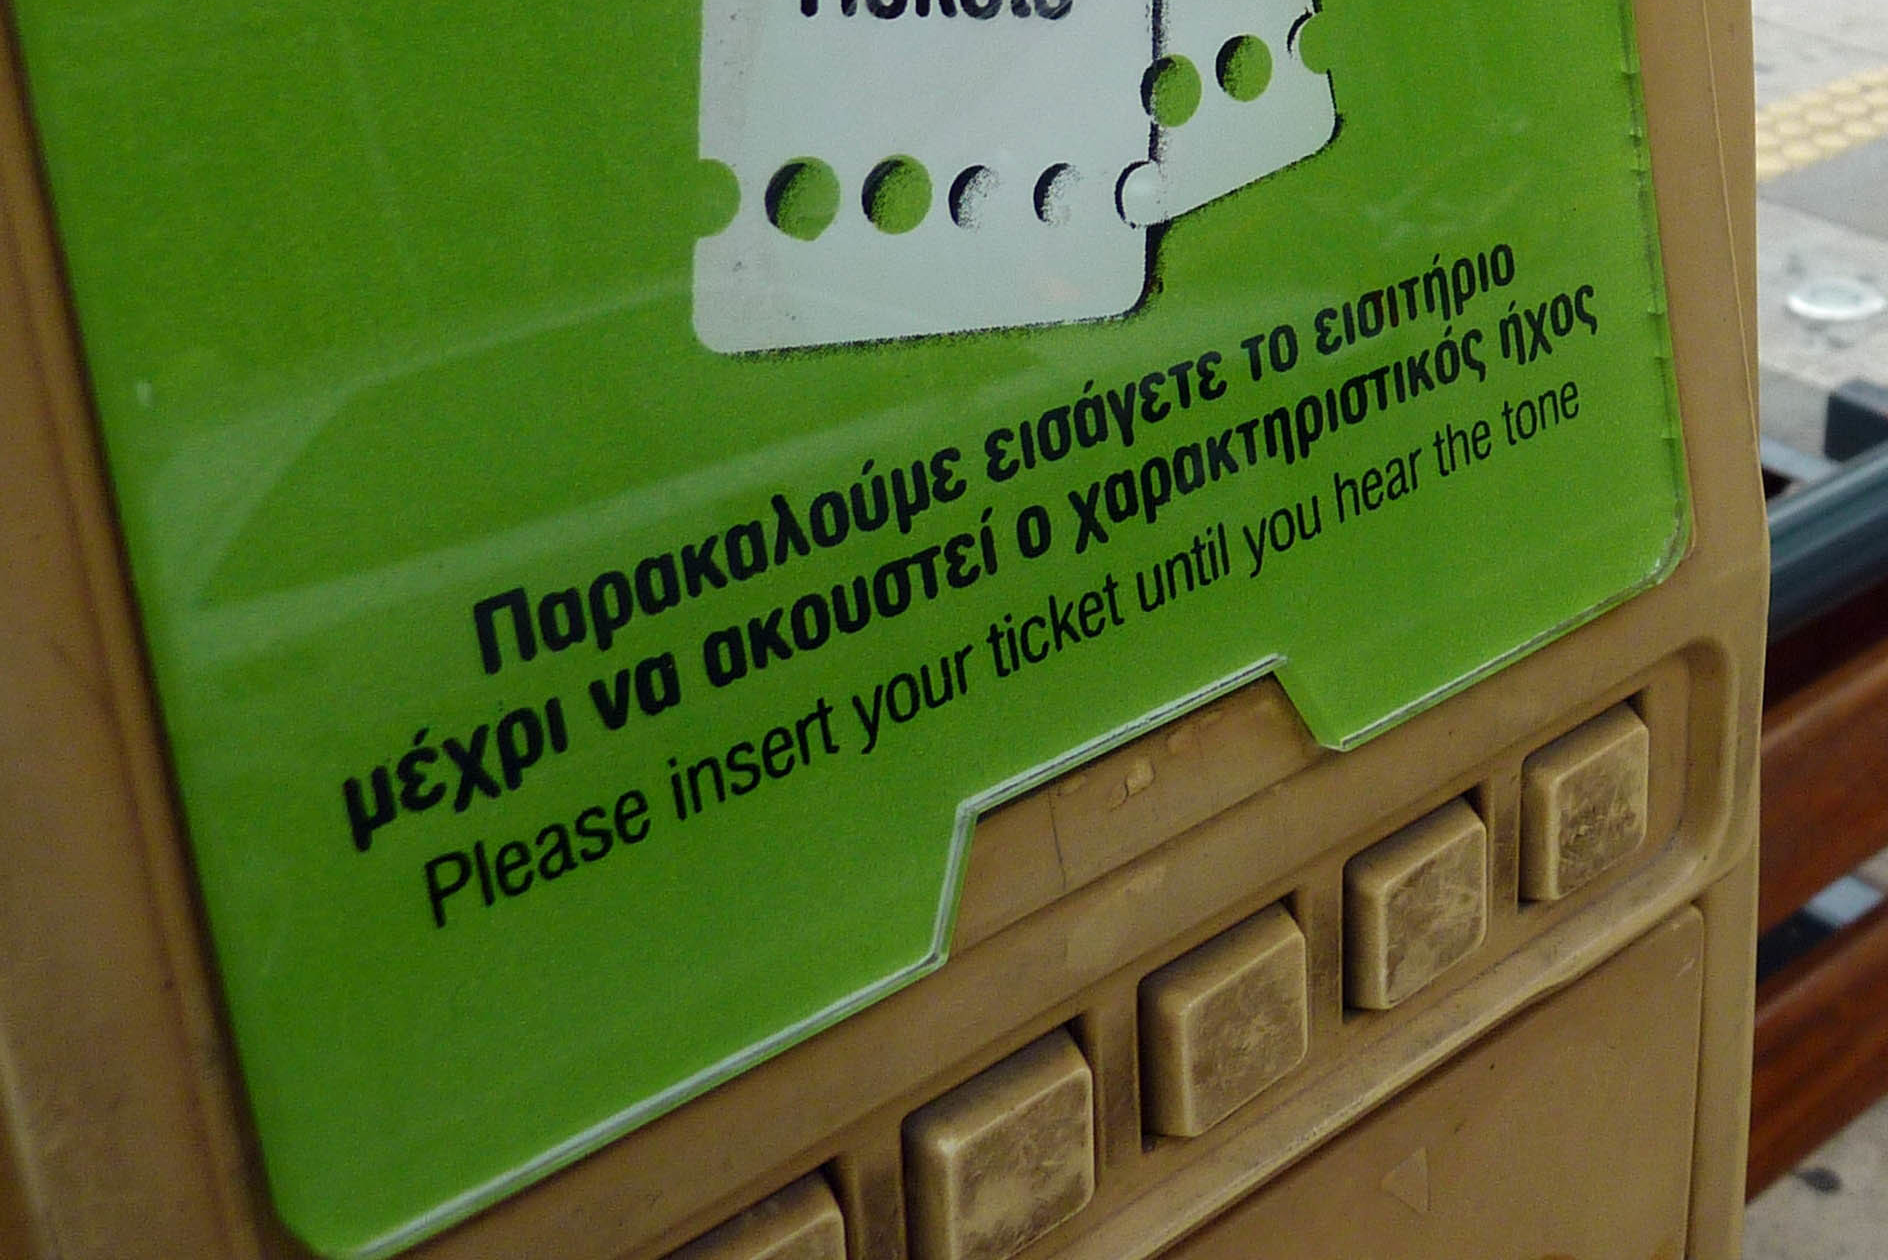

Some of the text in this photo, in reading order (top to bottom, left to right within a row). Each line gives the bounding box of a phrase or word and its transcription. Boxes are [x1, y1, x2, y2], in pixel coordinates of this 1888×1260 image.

[342, 284, 1598, 853] μέχρι να ακουστεί ο χαρακτηριστικός ήχος
[424, 381, 1581, 928] Please insert your ticket until you hear the tone
[473, 243, 1515, 674] Παρακαλούμε εισάγετε το εισιτήριο
